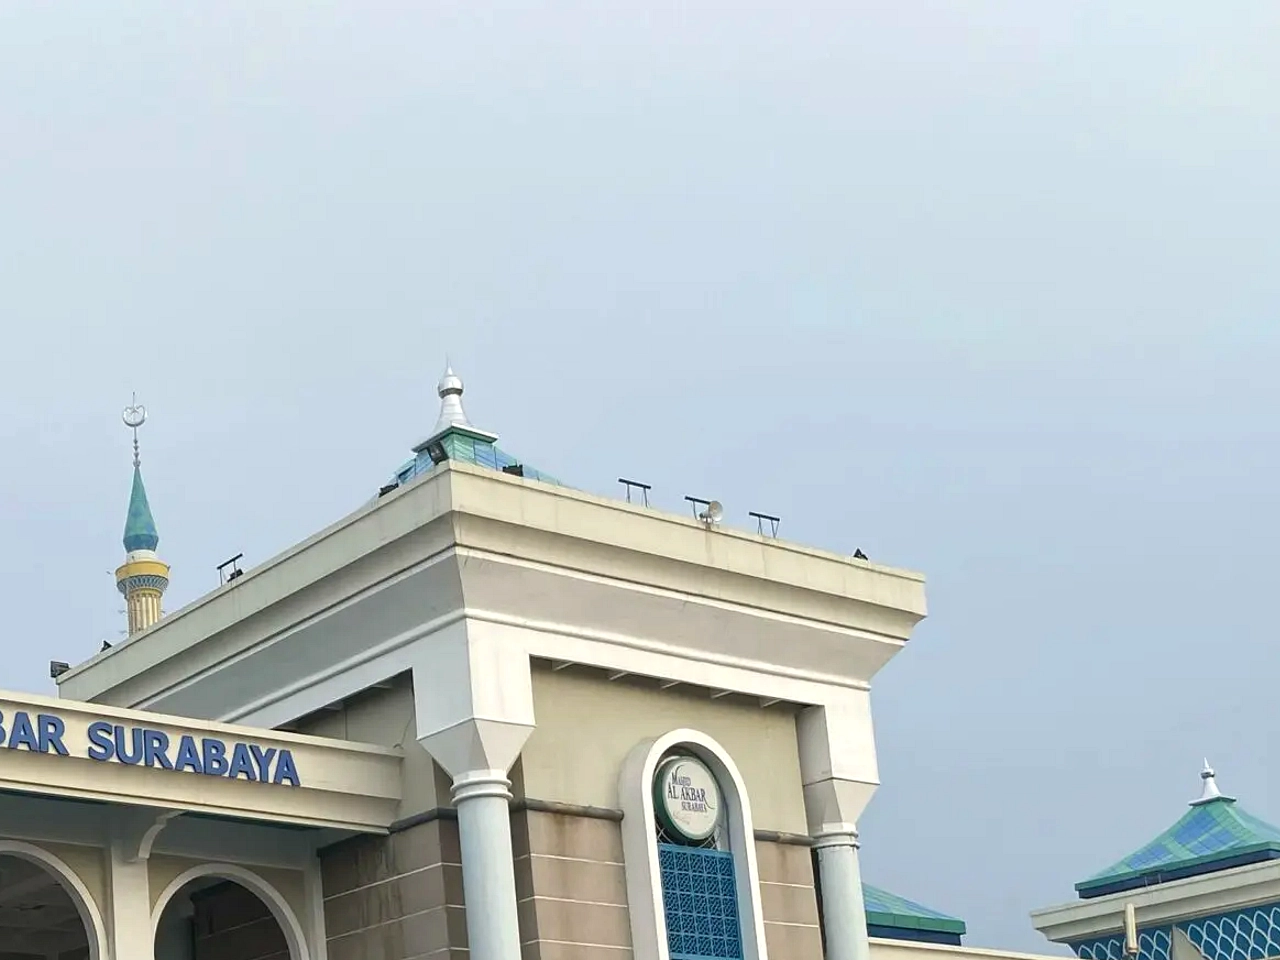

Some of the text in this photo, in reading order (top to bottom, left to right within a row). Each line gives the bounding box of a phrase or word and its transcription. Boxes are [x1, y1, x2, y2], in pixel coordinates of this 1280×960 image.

[87, 721, 302, 787] SURABAYA
[667, 781, 715, 809] AL AKBAR
